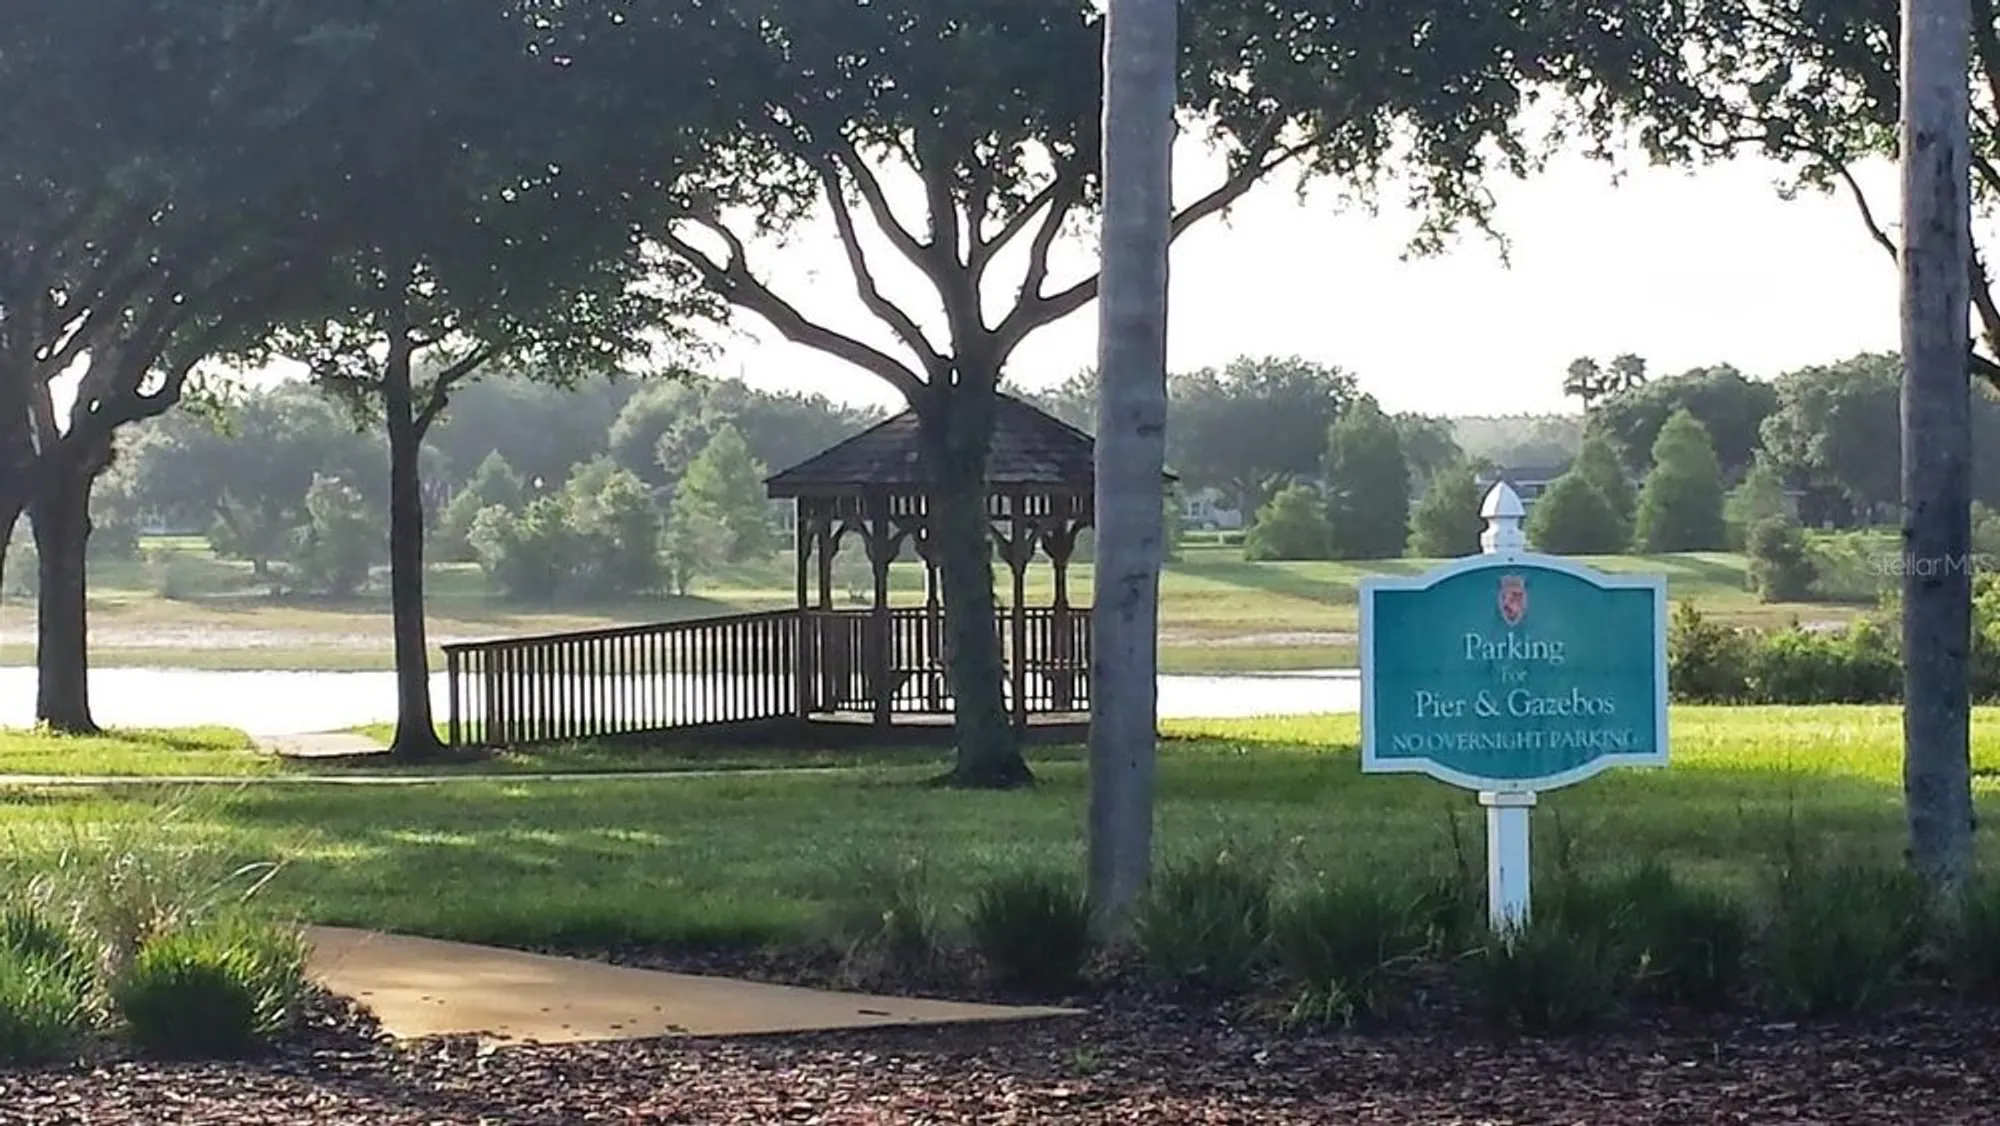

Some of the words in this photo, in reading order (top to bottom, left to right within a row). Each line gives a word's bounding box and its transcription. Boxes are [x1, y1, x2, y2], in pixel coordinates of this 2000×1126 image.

[1465, 631, 1565, 664] Parking
[1416, 690, 1465, 717] Pier
[1475, 689, 1500, 716] &
[1507, 688, 1615, 717] Gazebos
[1392, 734, 1424, 751] NO
[1427, 732, 1544, 750] OVERNIGHT
[1550, 729, 1638, 749] PARKING
